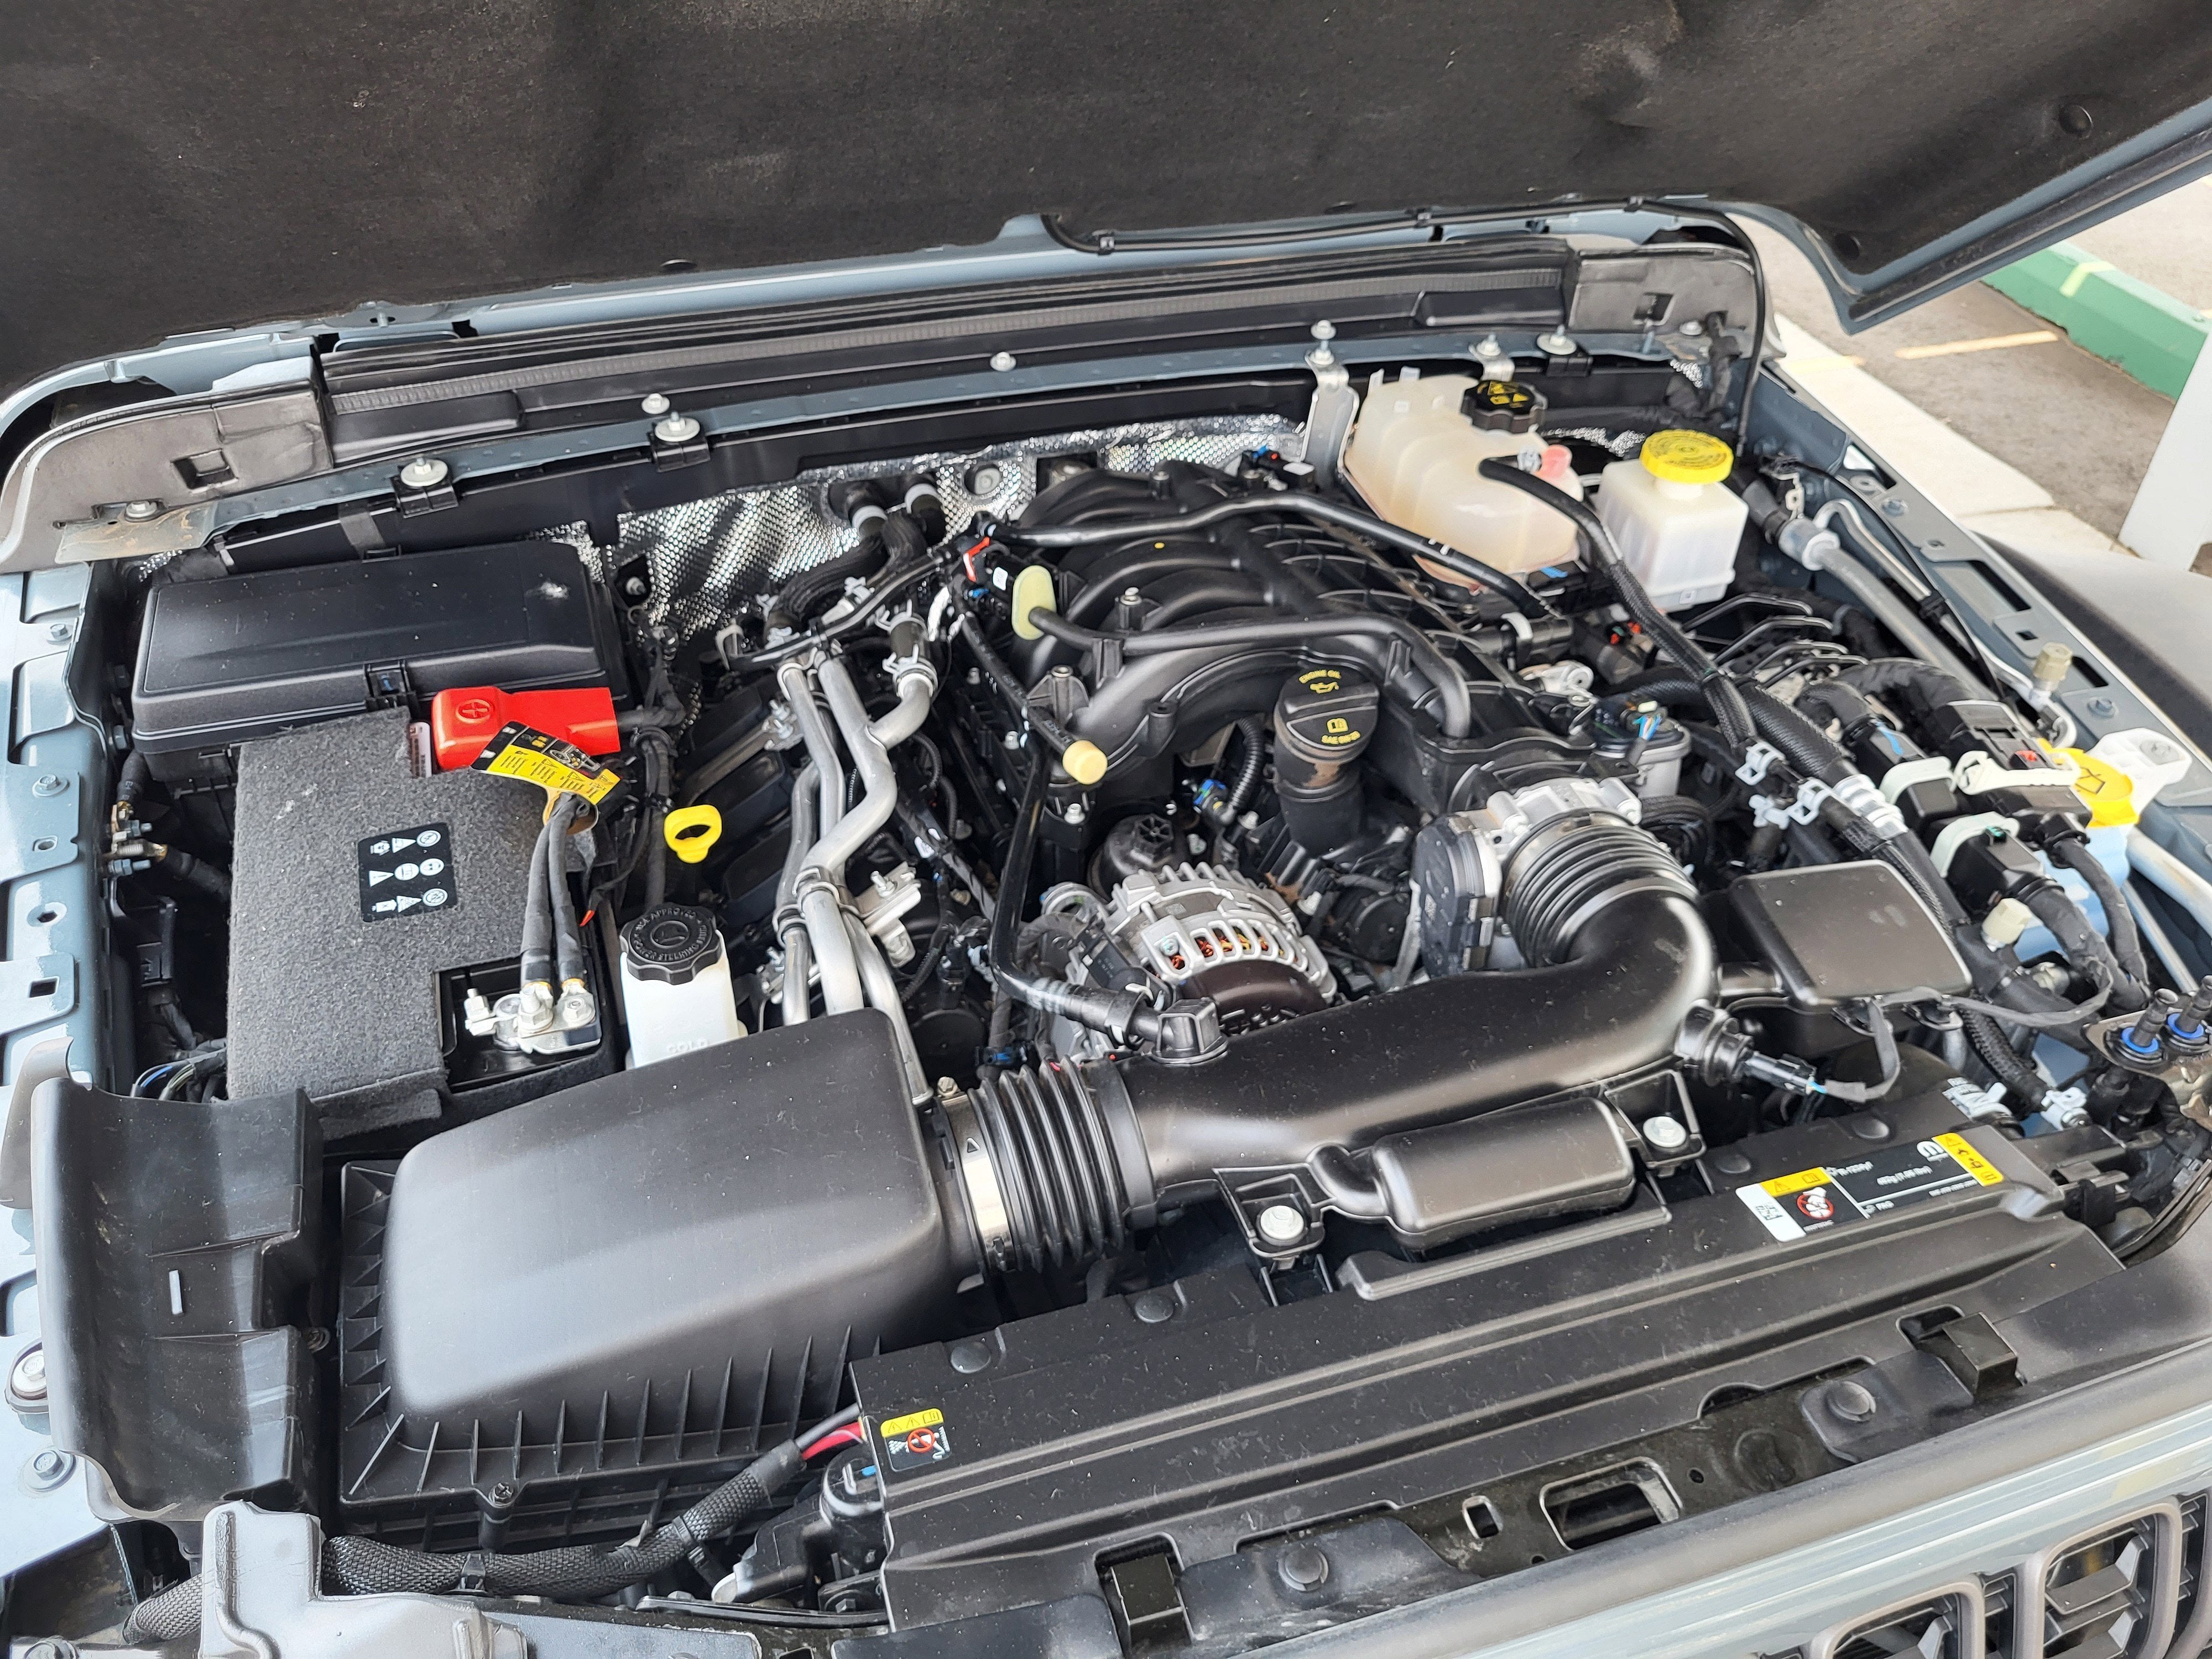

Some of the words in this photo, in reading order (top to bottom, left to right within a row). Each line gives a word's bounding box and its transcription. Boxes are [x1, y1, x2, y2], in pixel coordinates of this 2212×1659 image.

[1298, 669, 1327, 684] ENGINE
[1327, 670, 1342, 679] OIL
[1321, 734, 1339, 745] SAE
